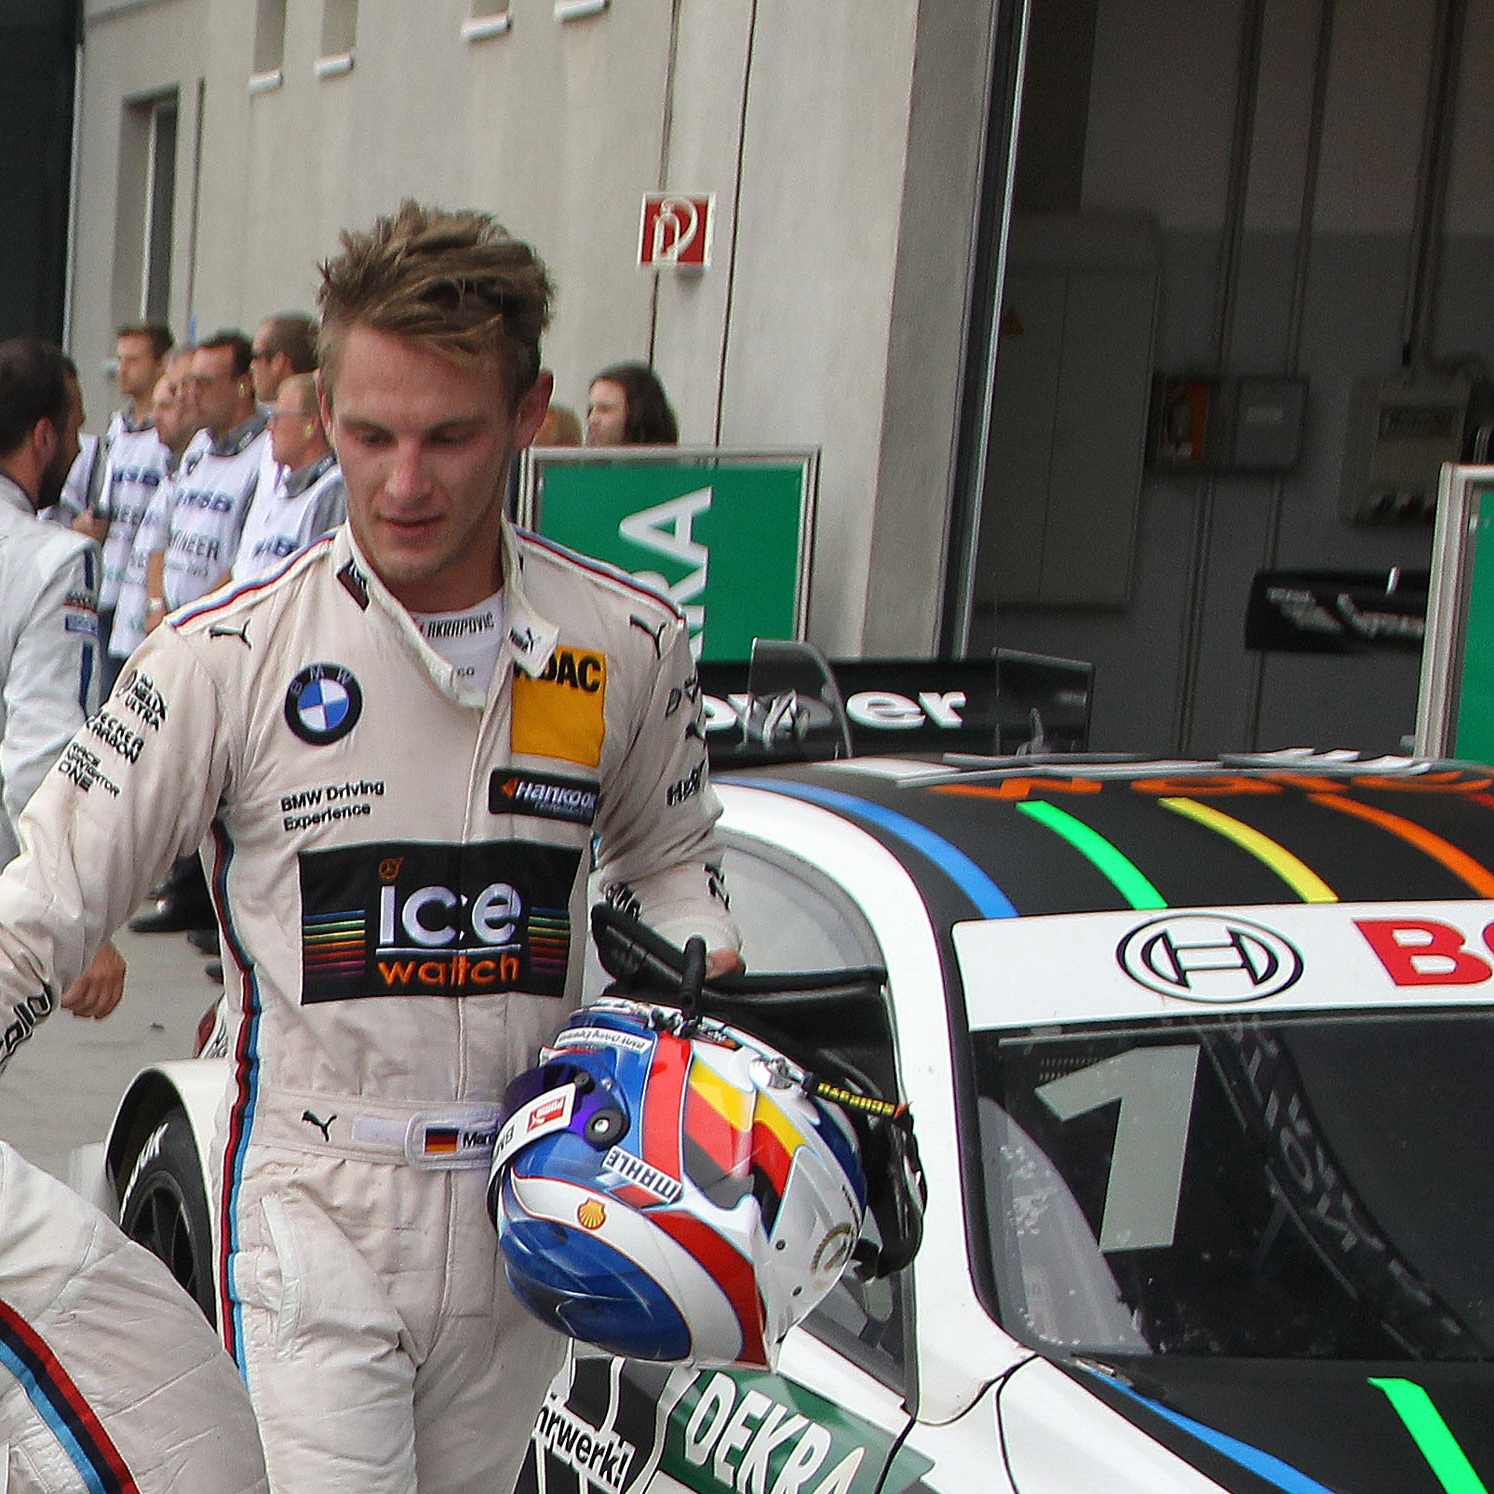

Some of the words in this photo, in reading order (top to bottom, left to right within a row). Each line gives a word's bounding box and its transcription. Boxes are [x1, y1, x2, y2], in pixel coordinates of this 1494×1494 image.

[99, 710, 145, 750] ECKER
[281, 788, 322, 812] BMW
[326, 779, 385, 802] Driving
[283, 801, 371, 832] Experience
[380, 883, 523, 947] ice
[378, 951, 521, 987] watch
[1034, 1044, 1200, 1253] 1
[606, 1149, 679, 1200] MAHLE
